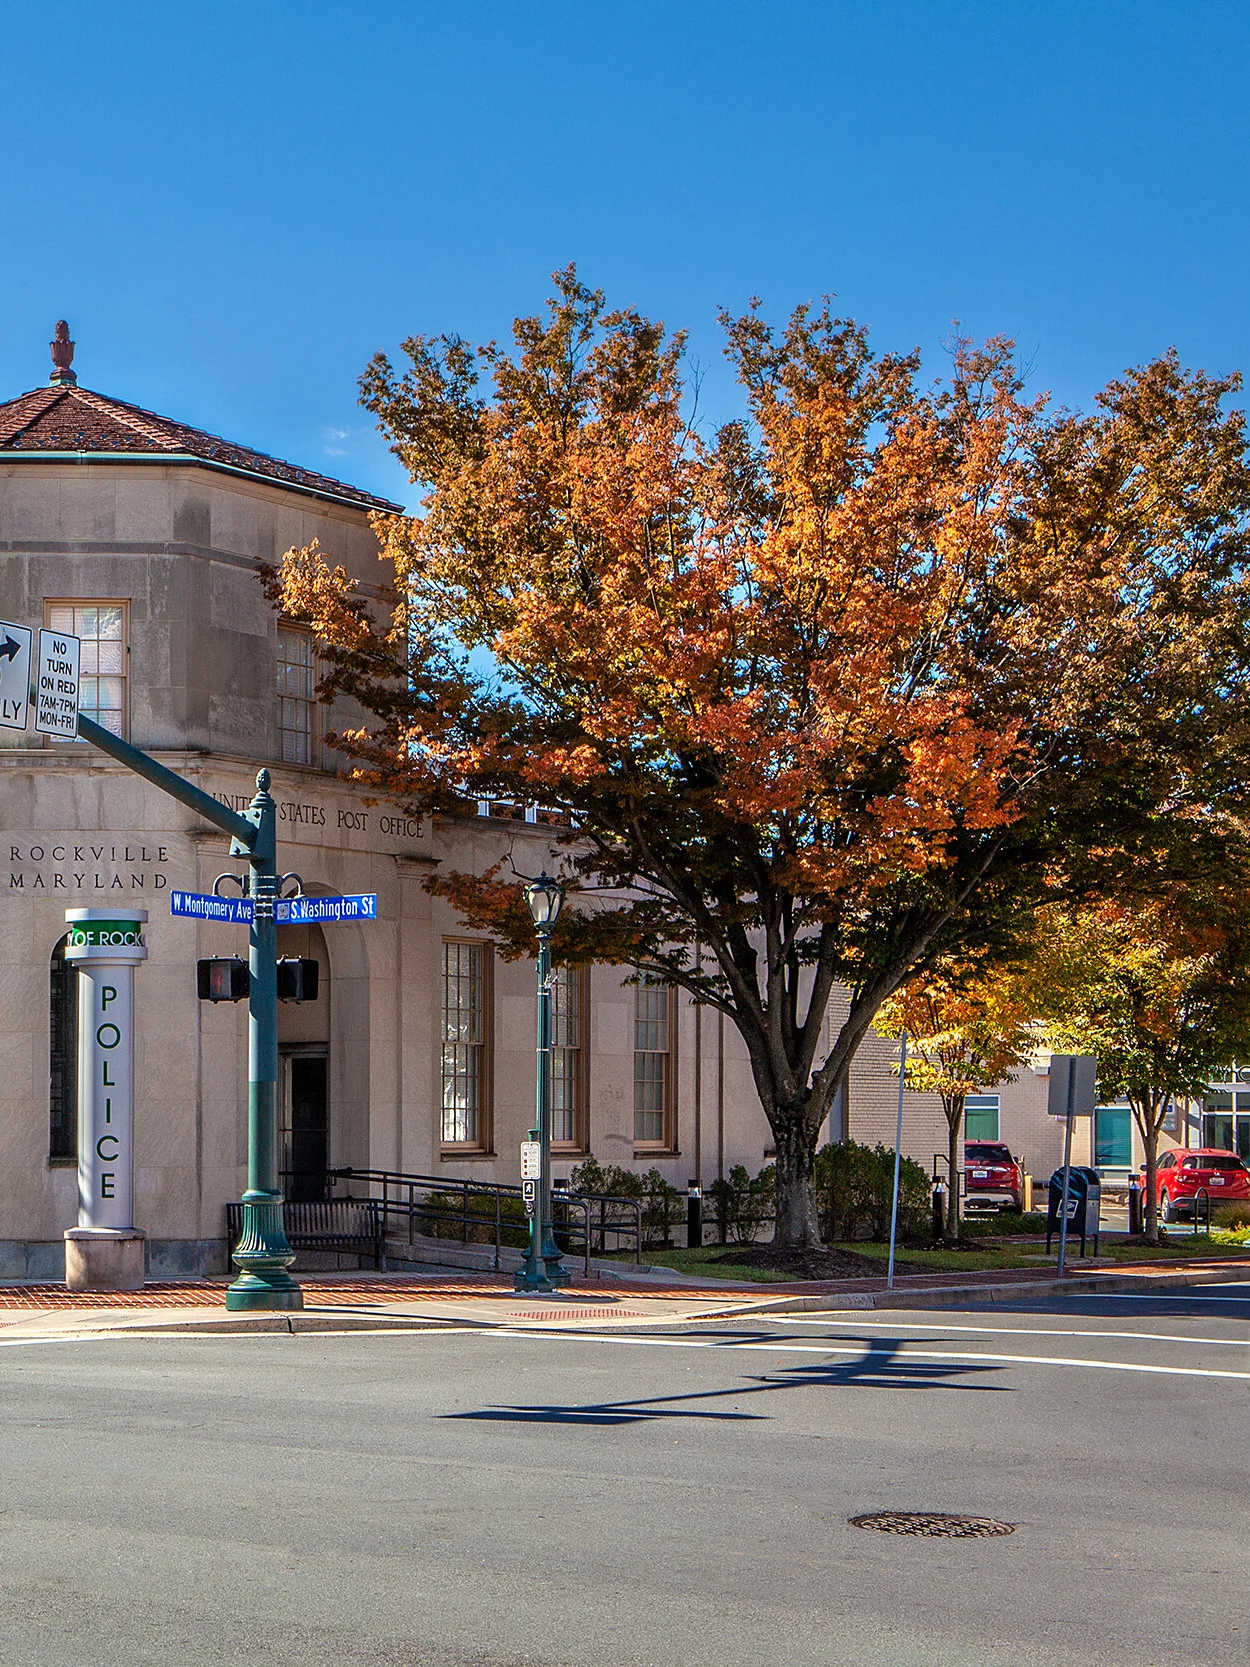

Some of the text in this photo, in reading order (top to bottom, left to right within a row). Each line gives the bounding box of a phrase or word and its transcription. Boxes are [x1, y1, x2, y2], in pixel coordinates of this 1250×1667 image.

[53, 640, 67, 655] NO
[47, 659, 72, 675] TURN
[41, 676, 76, 694] ON RED
[40, 695, 76, 713] 7AM-7PM
[39, 711, 75, 729] MON-FRI
[280, 802, 326, 826] STATES
[337, 810, 369, 831] POST
[380, 816, 424, 839] OFFICE
[9, 846, 169, 862] ROCKVILLE
[9, 873, 167, 889] MARYLAND
[236, 901, 252, 919] Ave
[361, 896, 374, 915] St
[74, 931, 94, 946] OF
[99, 931, 146, 946] ROCK
[96, 986, 121, 1199] POLICE
